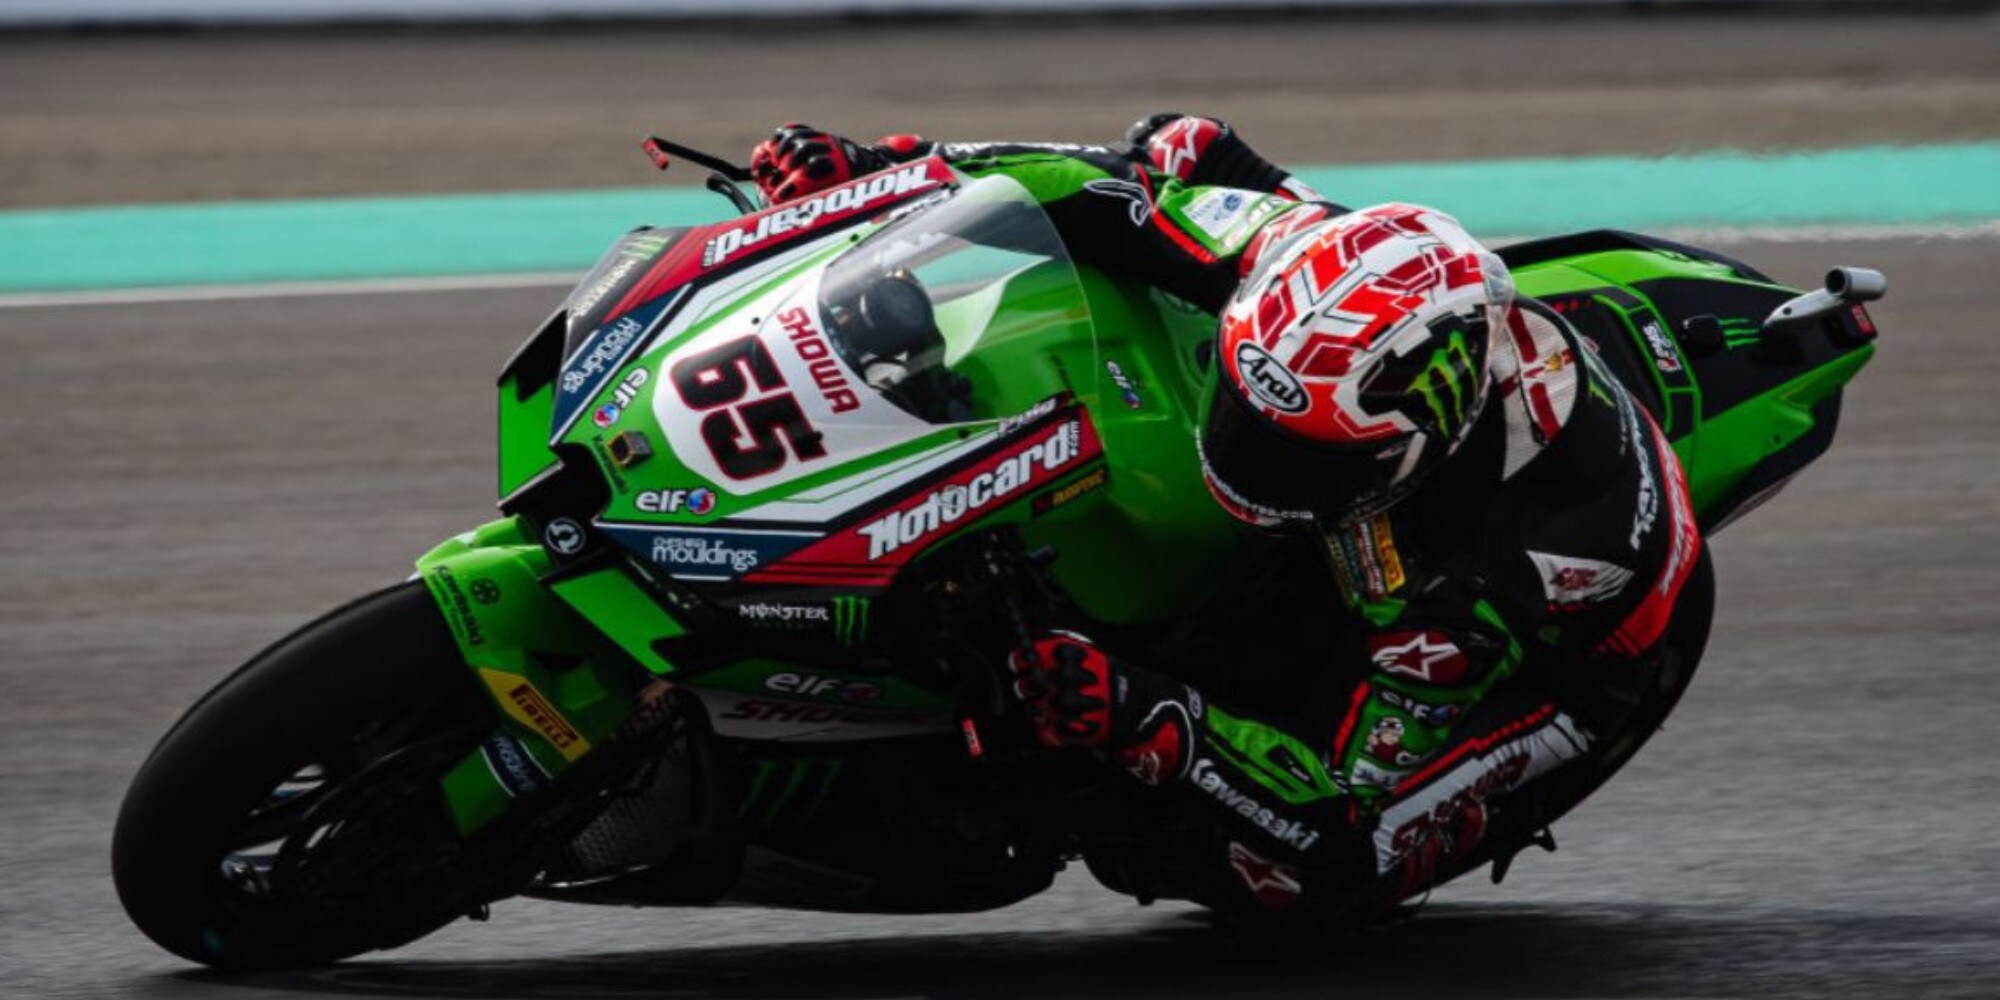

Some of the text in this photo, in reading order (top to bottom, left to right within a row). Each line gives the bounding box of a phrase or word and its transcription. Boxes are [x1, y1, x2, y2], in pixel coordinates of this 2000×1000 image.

[713, 164, 937, 264] Motocard
[669, 333, 828, 481] 65
[777, 307, 861, 414] SHOWA
[1238, 350, 1303, 404] Arai
[857, 424, 1070, 561] Motocard
[652, 539, 758, 572] mouldings
